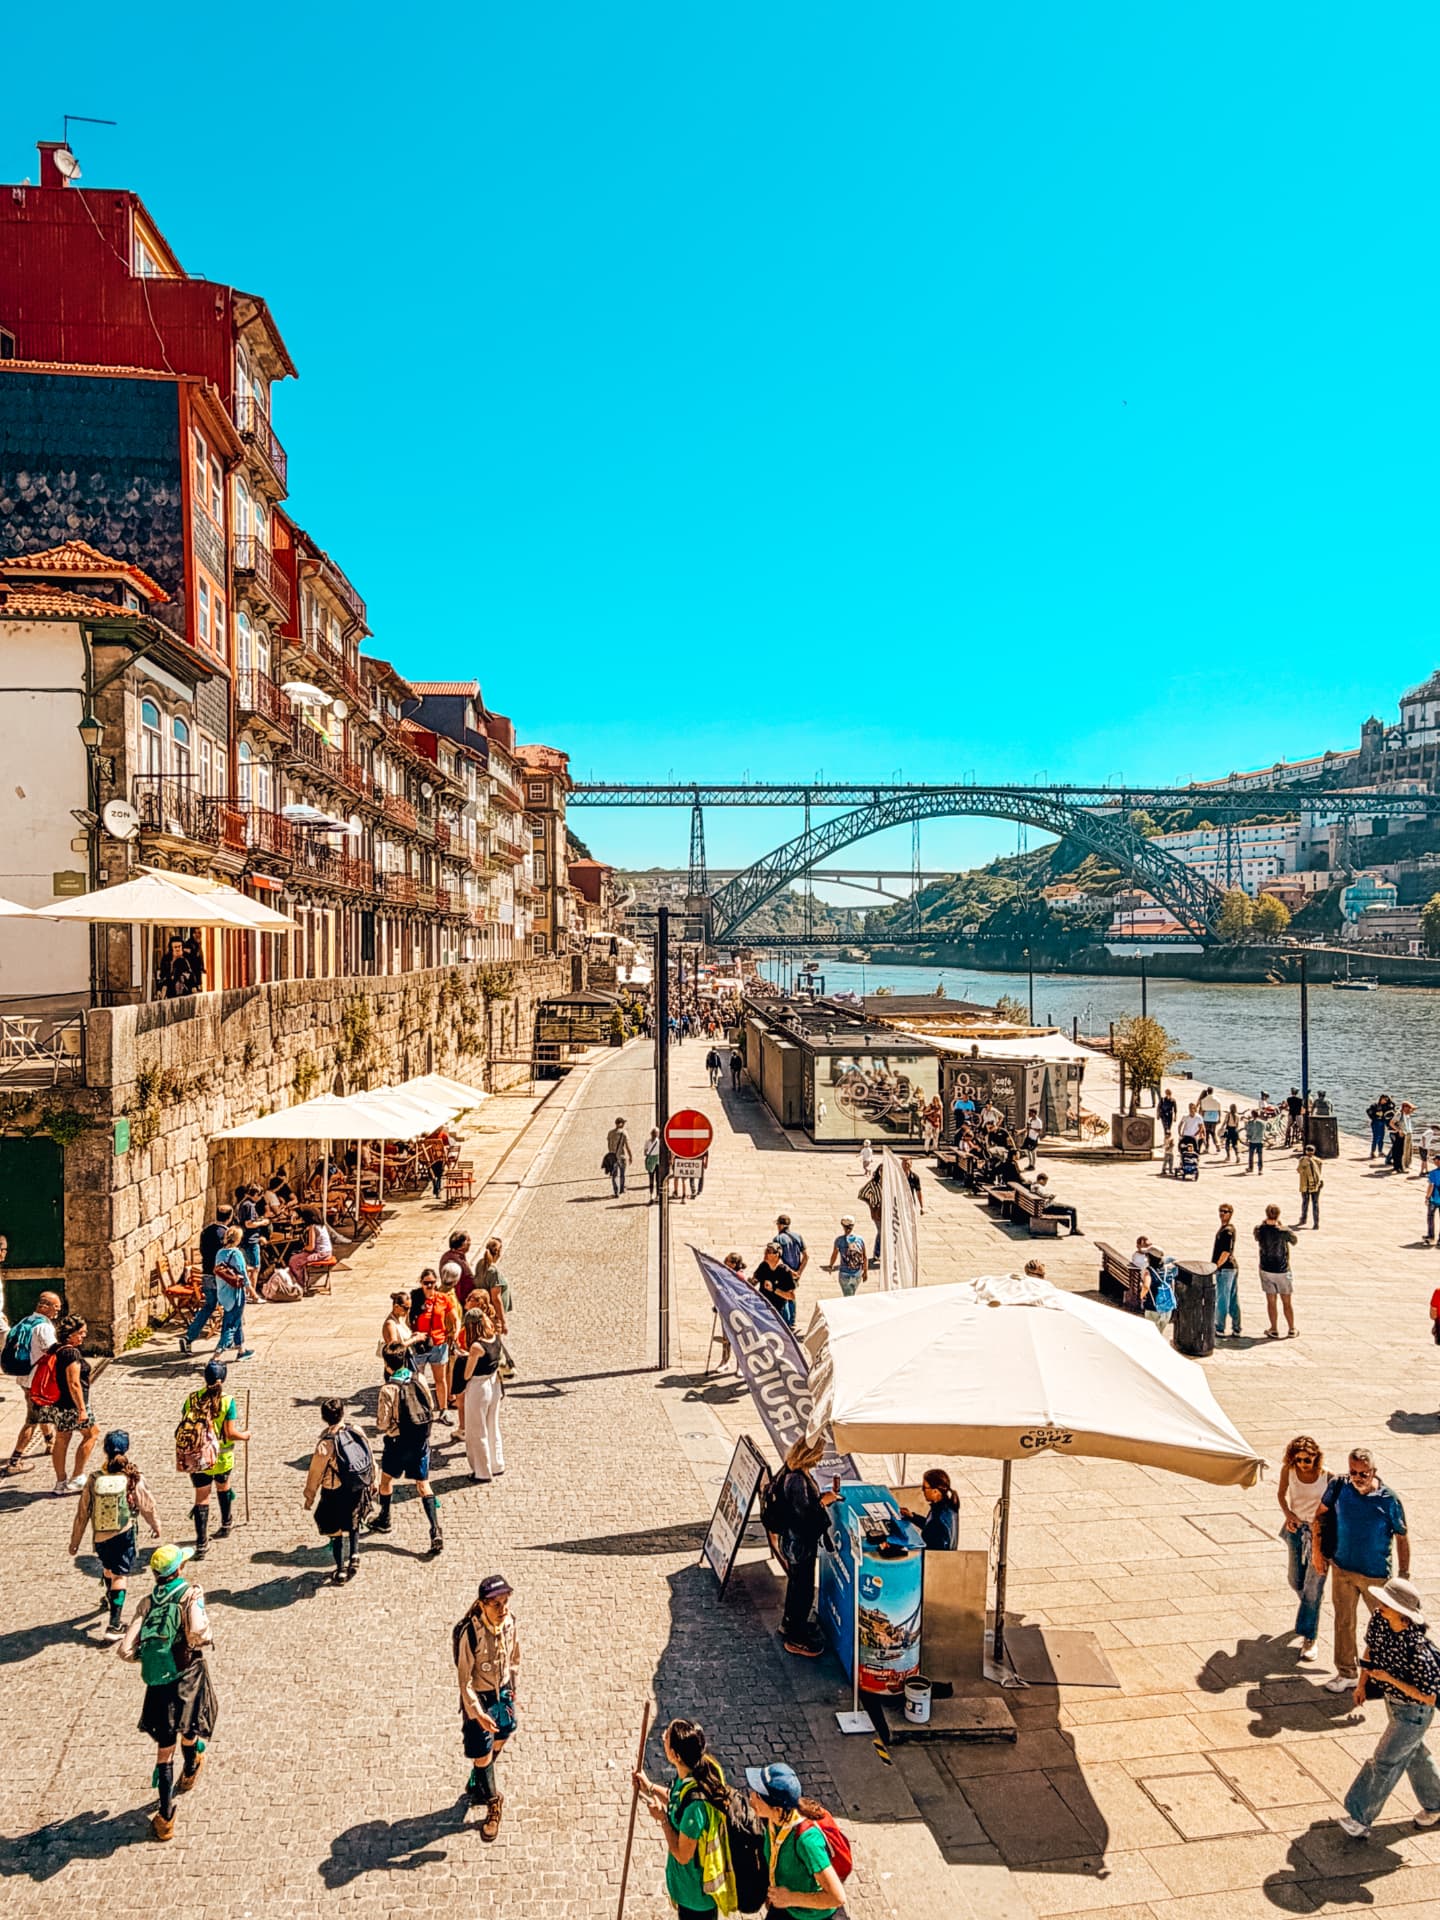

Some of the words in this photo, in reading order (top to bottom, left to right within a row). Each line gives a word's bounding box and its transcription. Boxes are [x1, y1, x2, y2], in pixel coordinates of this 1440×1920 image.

[111, 810, 130, 819] ZON
[957, 1072, 970, 1087] O
[1020, 1434, 1073, 1448] CRUZ
